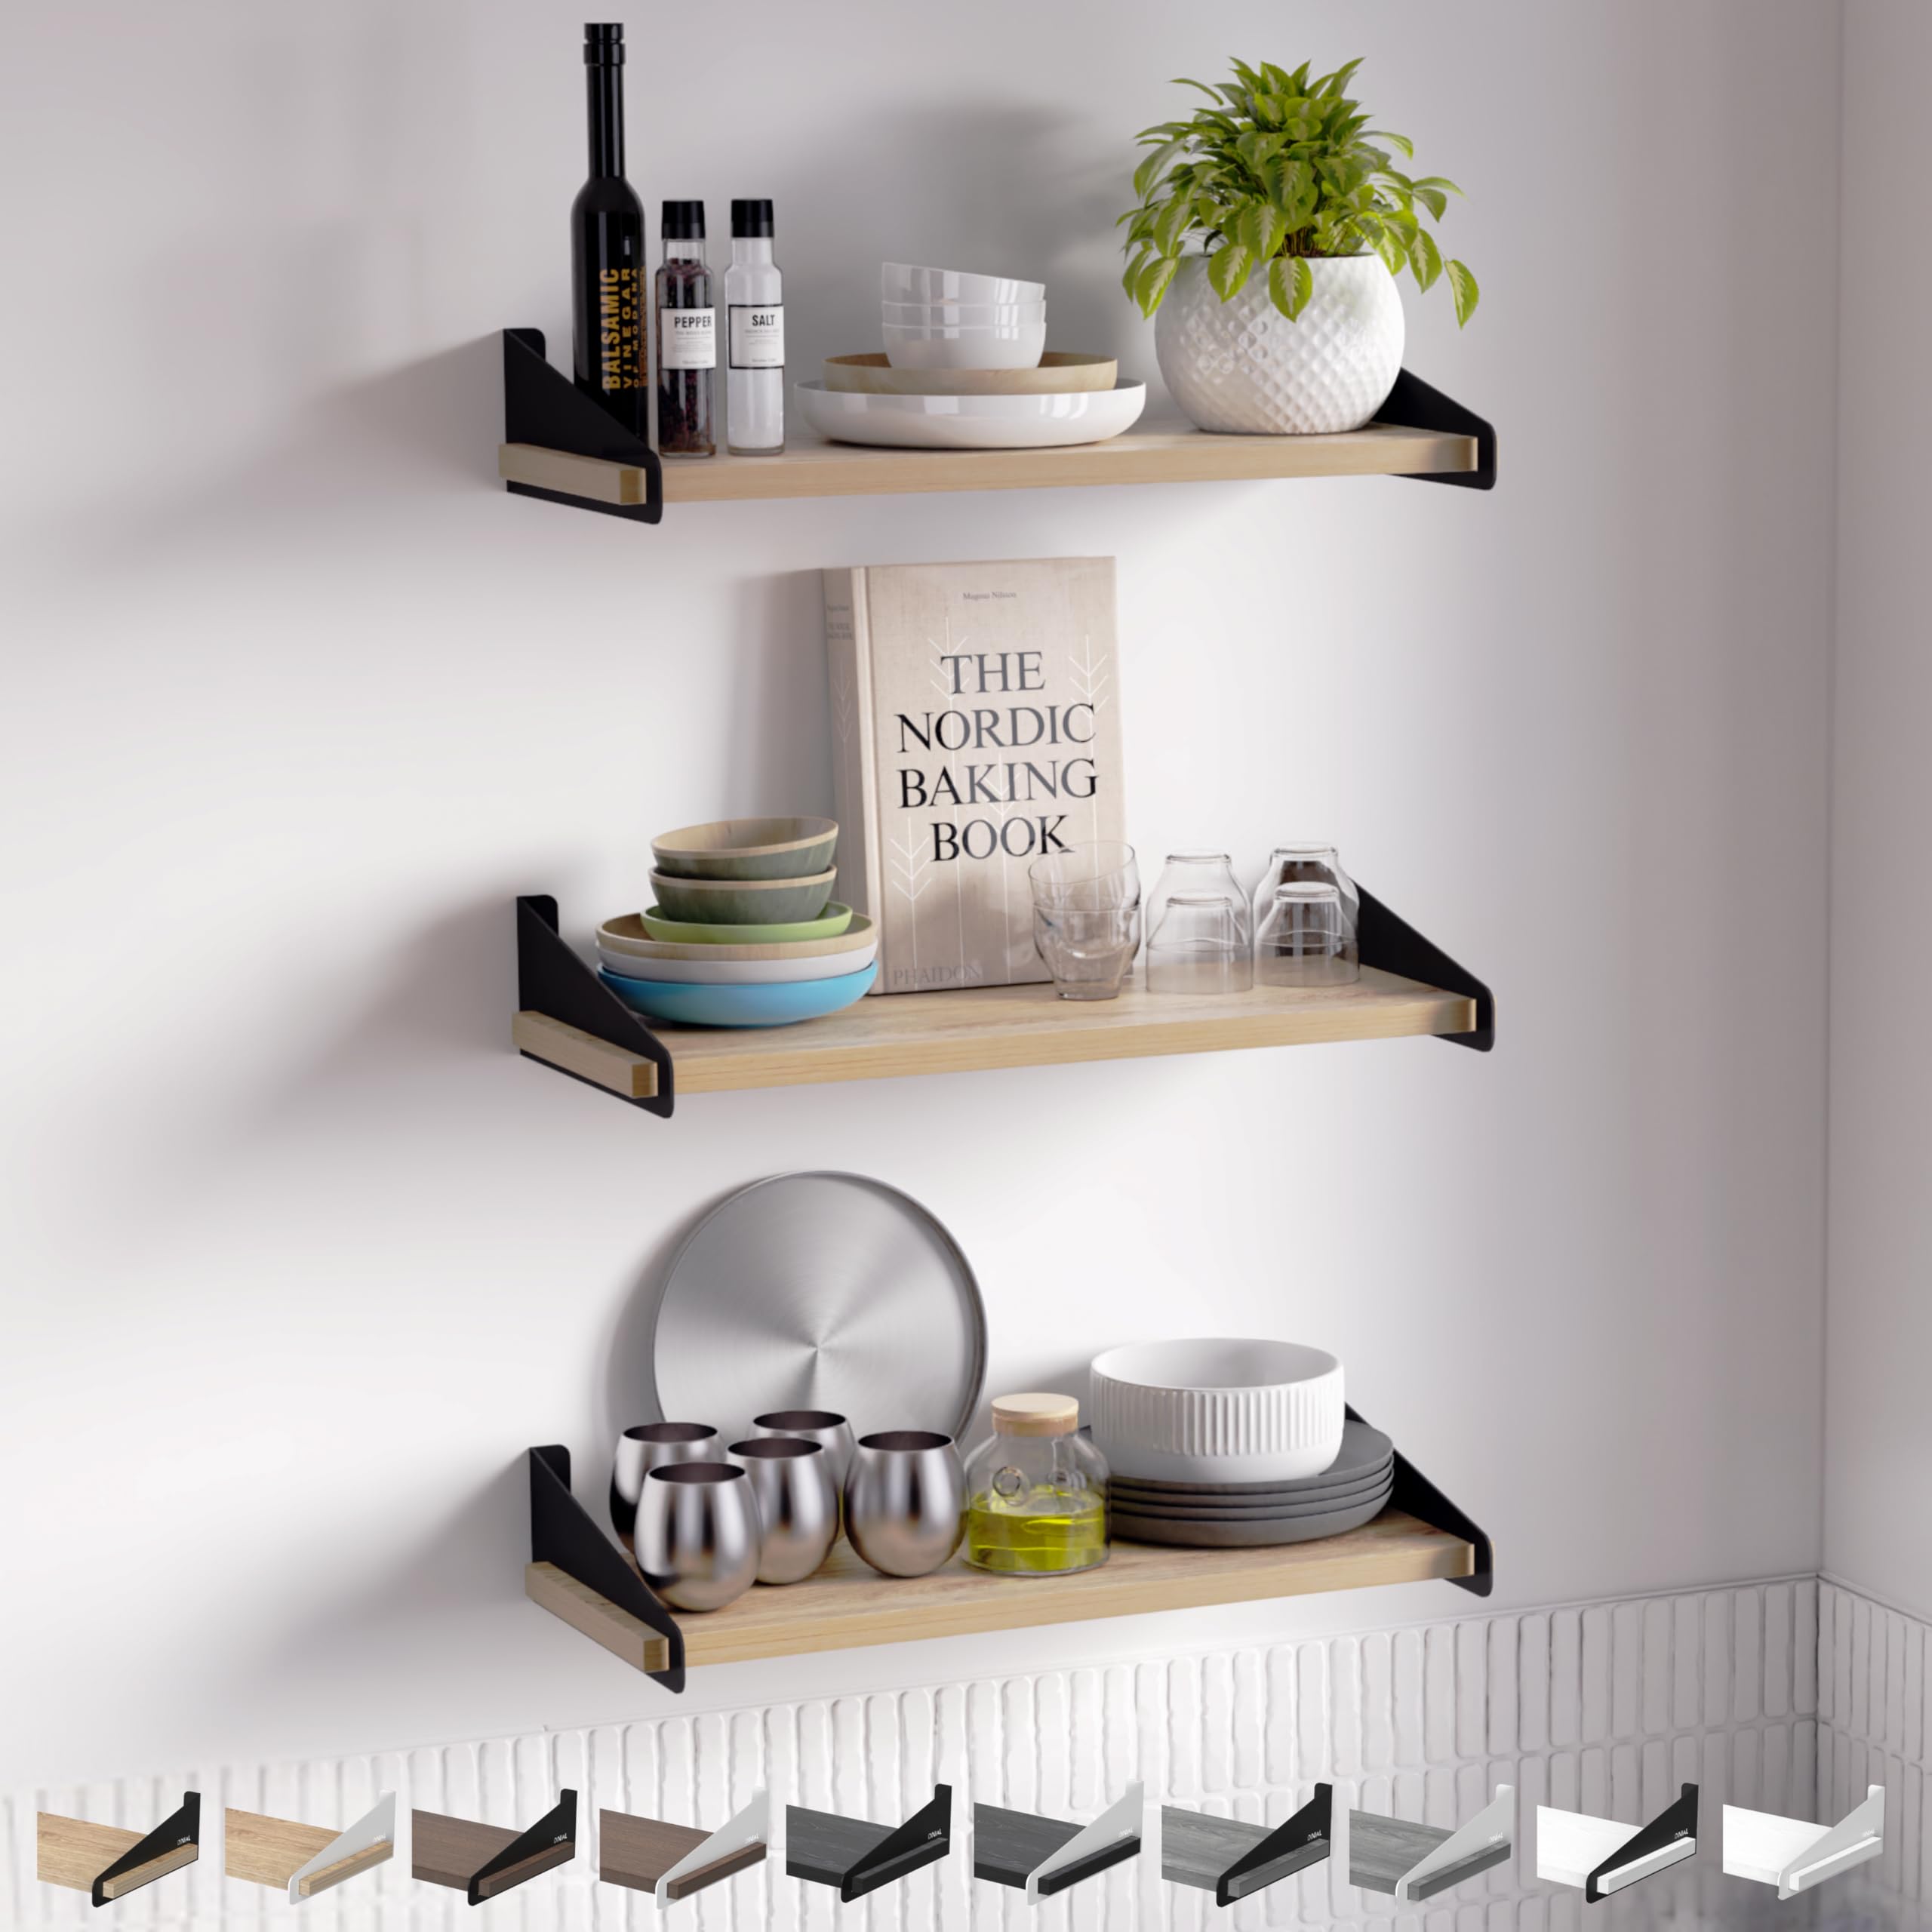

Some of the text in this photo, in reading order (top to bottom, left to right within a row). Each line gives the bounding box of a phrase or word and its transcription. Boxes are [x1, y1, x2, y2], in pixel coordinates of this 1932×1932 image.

[600, 269, 621, 389] BALSAMIC
[621, 268, 632, 389] VINEGAR
[674, 315, 712, 328] PEPPER
[752, 314, 775, 326] SALT
[632, 365, 639, 388] OF
[940, 651, 1046, 694] THE
[894, 703, 1096, 753] NORDIC
[897, 758, 1099, 808] BAKING
[930, 814, 1075, 862] BOOK
[893, 965, 983, 985] PHAIDON
